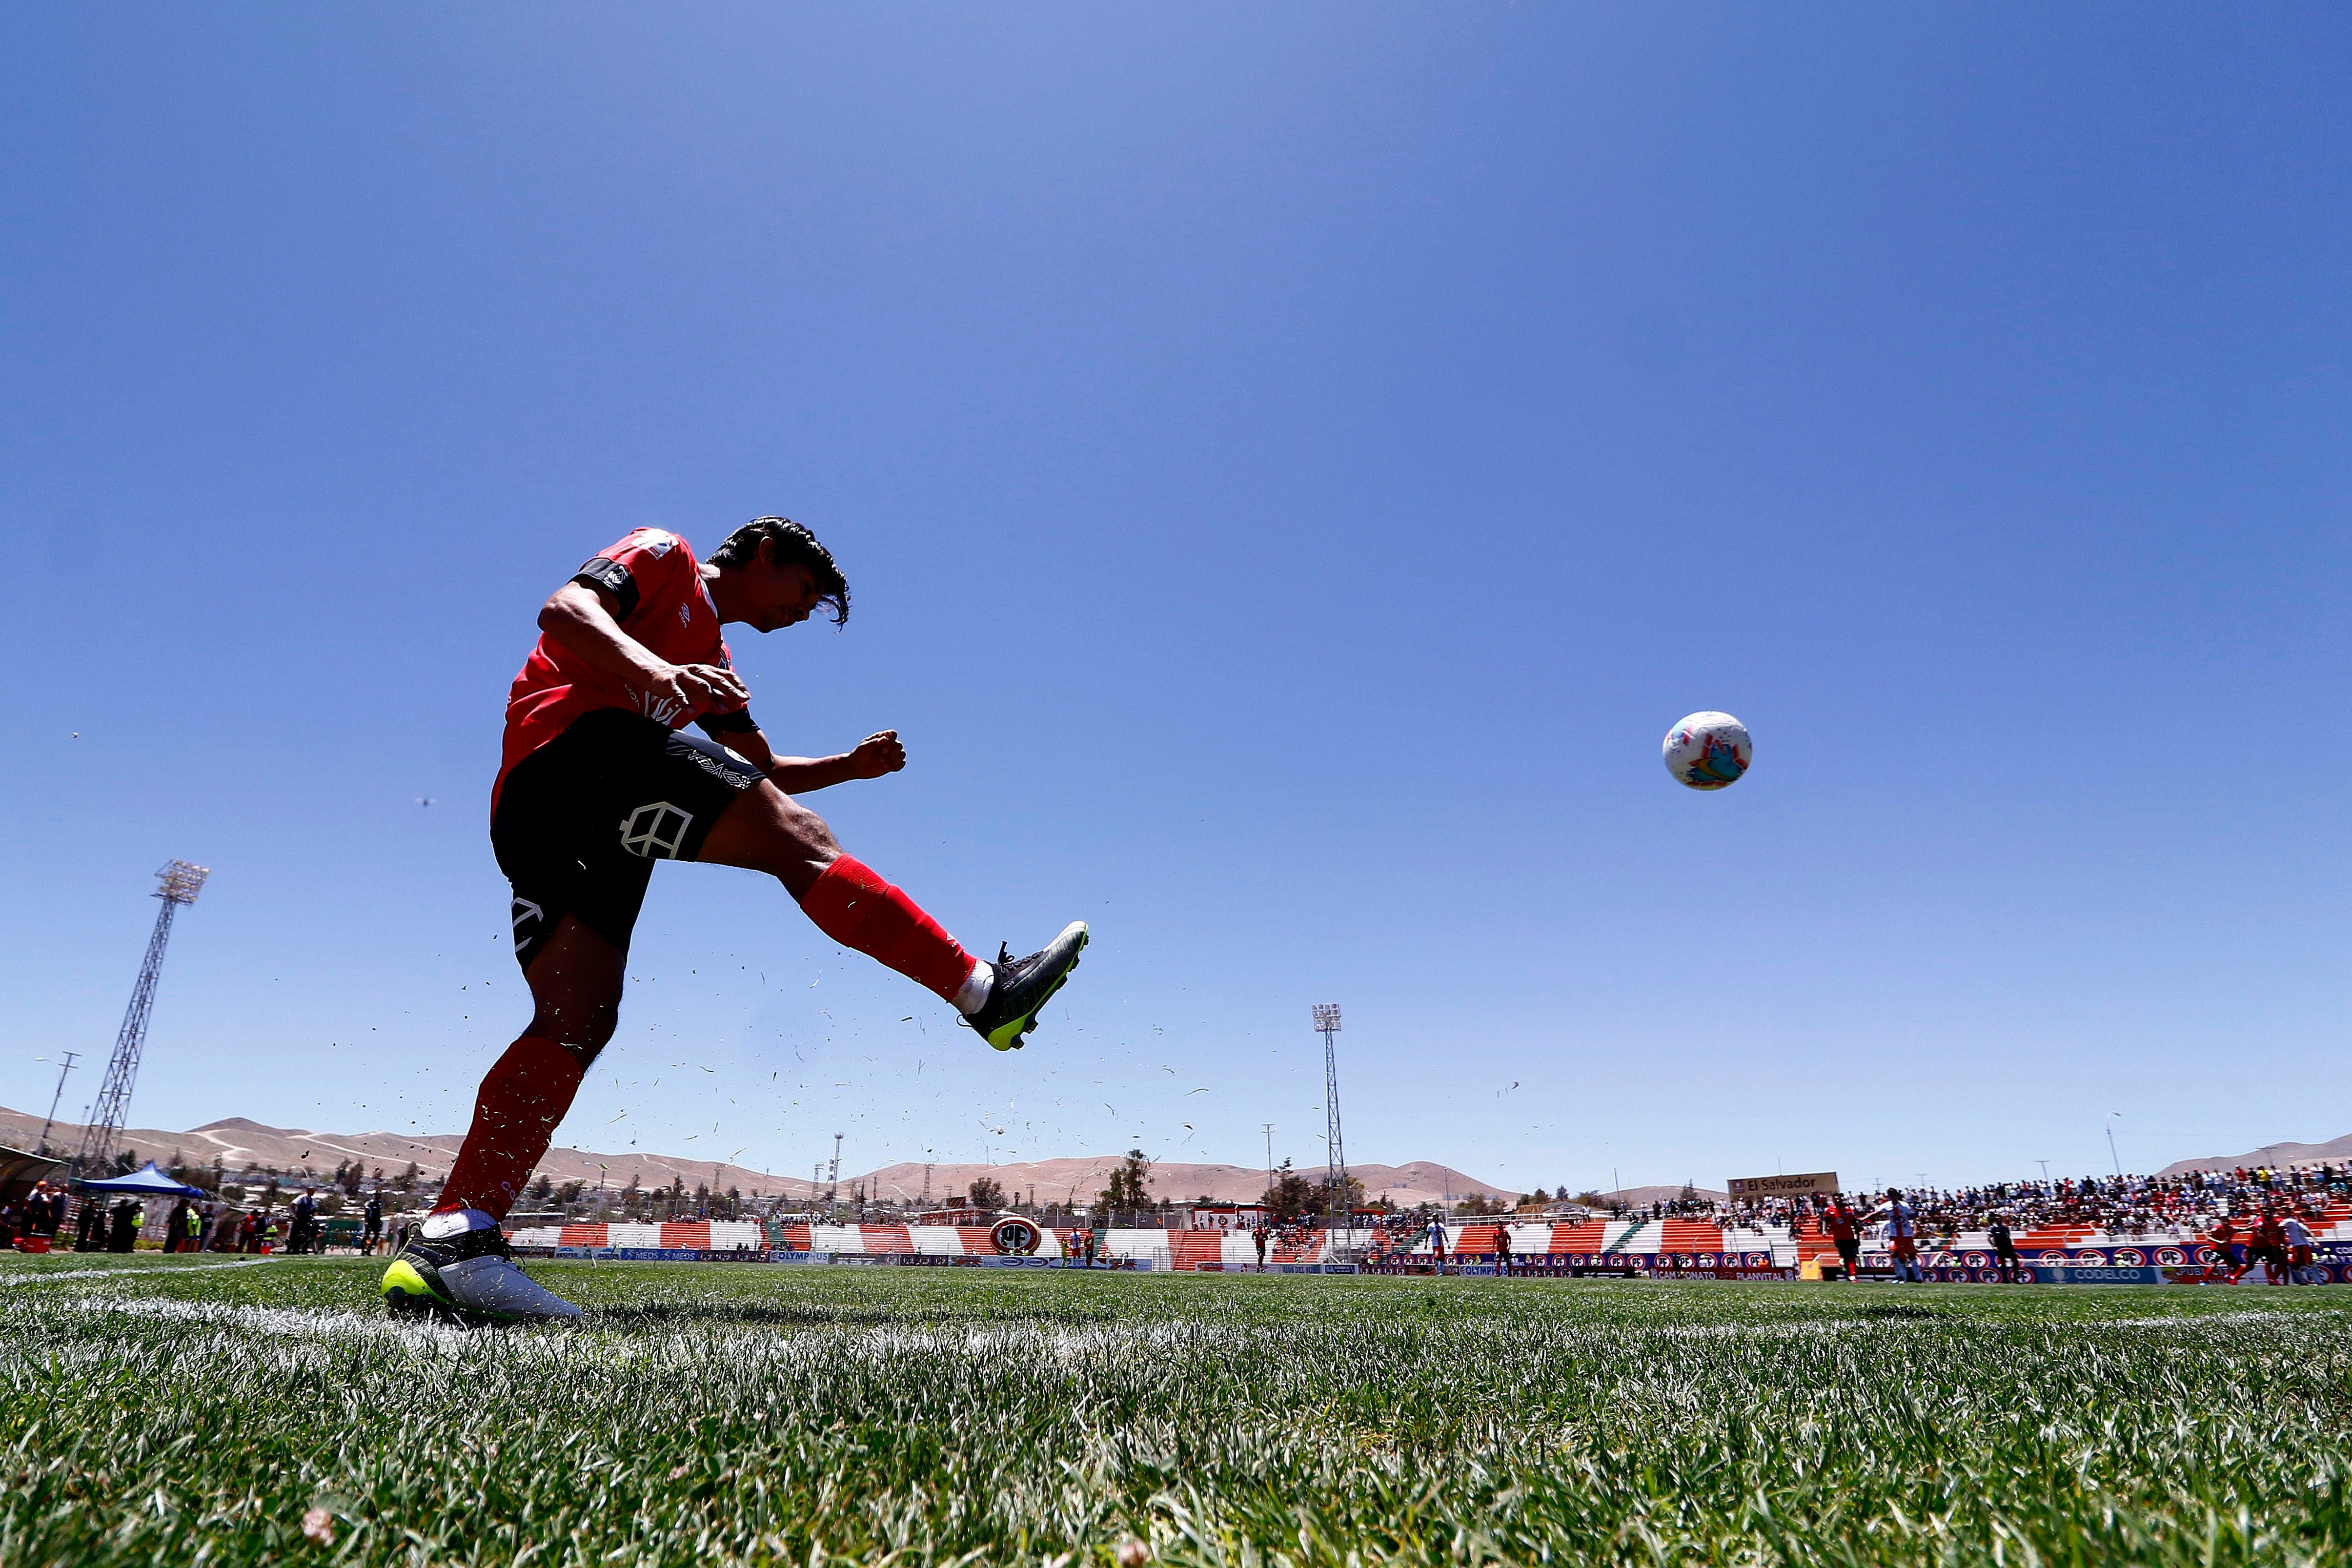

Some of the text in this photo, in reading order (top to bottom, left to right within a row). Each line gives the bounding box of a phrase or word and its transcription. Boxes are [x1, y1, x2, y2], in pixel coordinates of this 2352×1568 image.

[1747, 1177, 1816, 1191] El Salvador
[1001, 1224, 1028, 1247] PF
[635, 1252, 658, 1260] MEDS
[672, 1252, 695, 1261] MEDS
[778, 1251, 828, 1260] OLYMPUS
[2162, 1251, 2179, 1264] PF
[1659, 1271, 1716, 1280] CAMONATO
[1736, 1272, 1784, 1281] PLANVITAL
[2074, 1269, 2141, 1280] CODELCO
